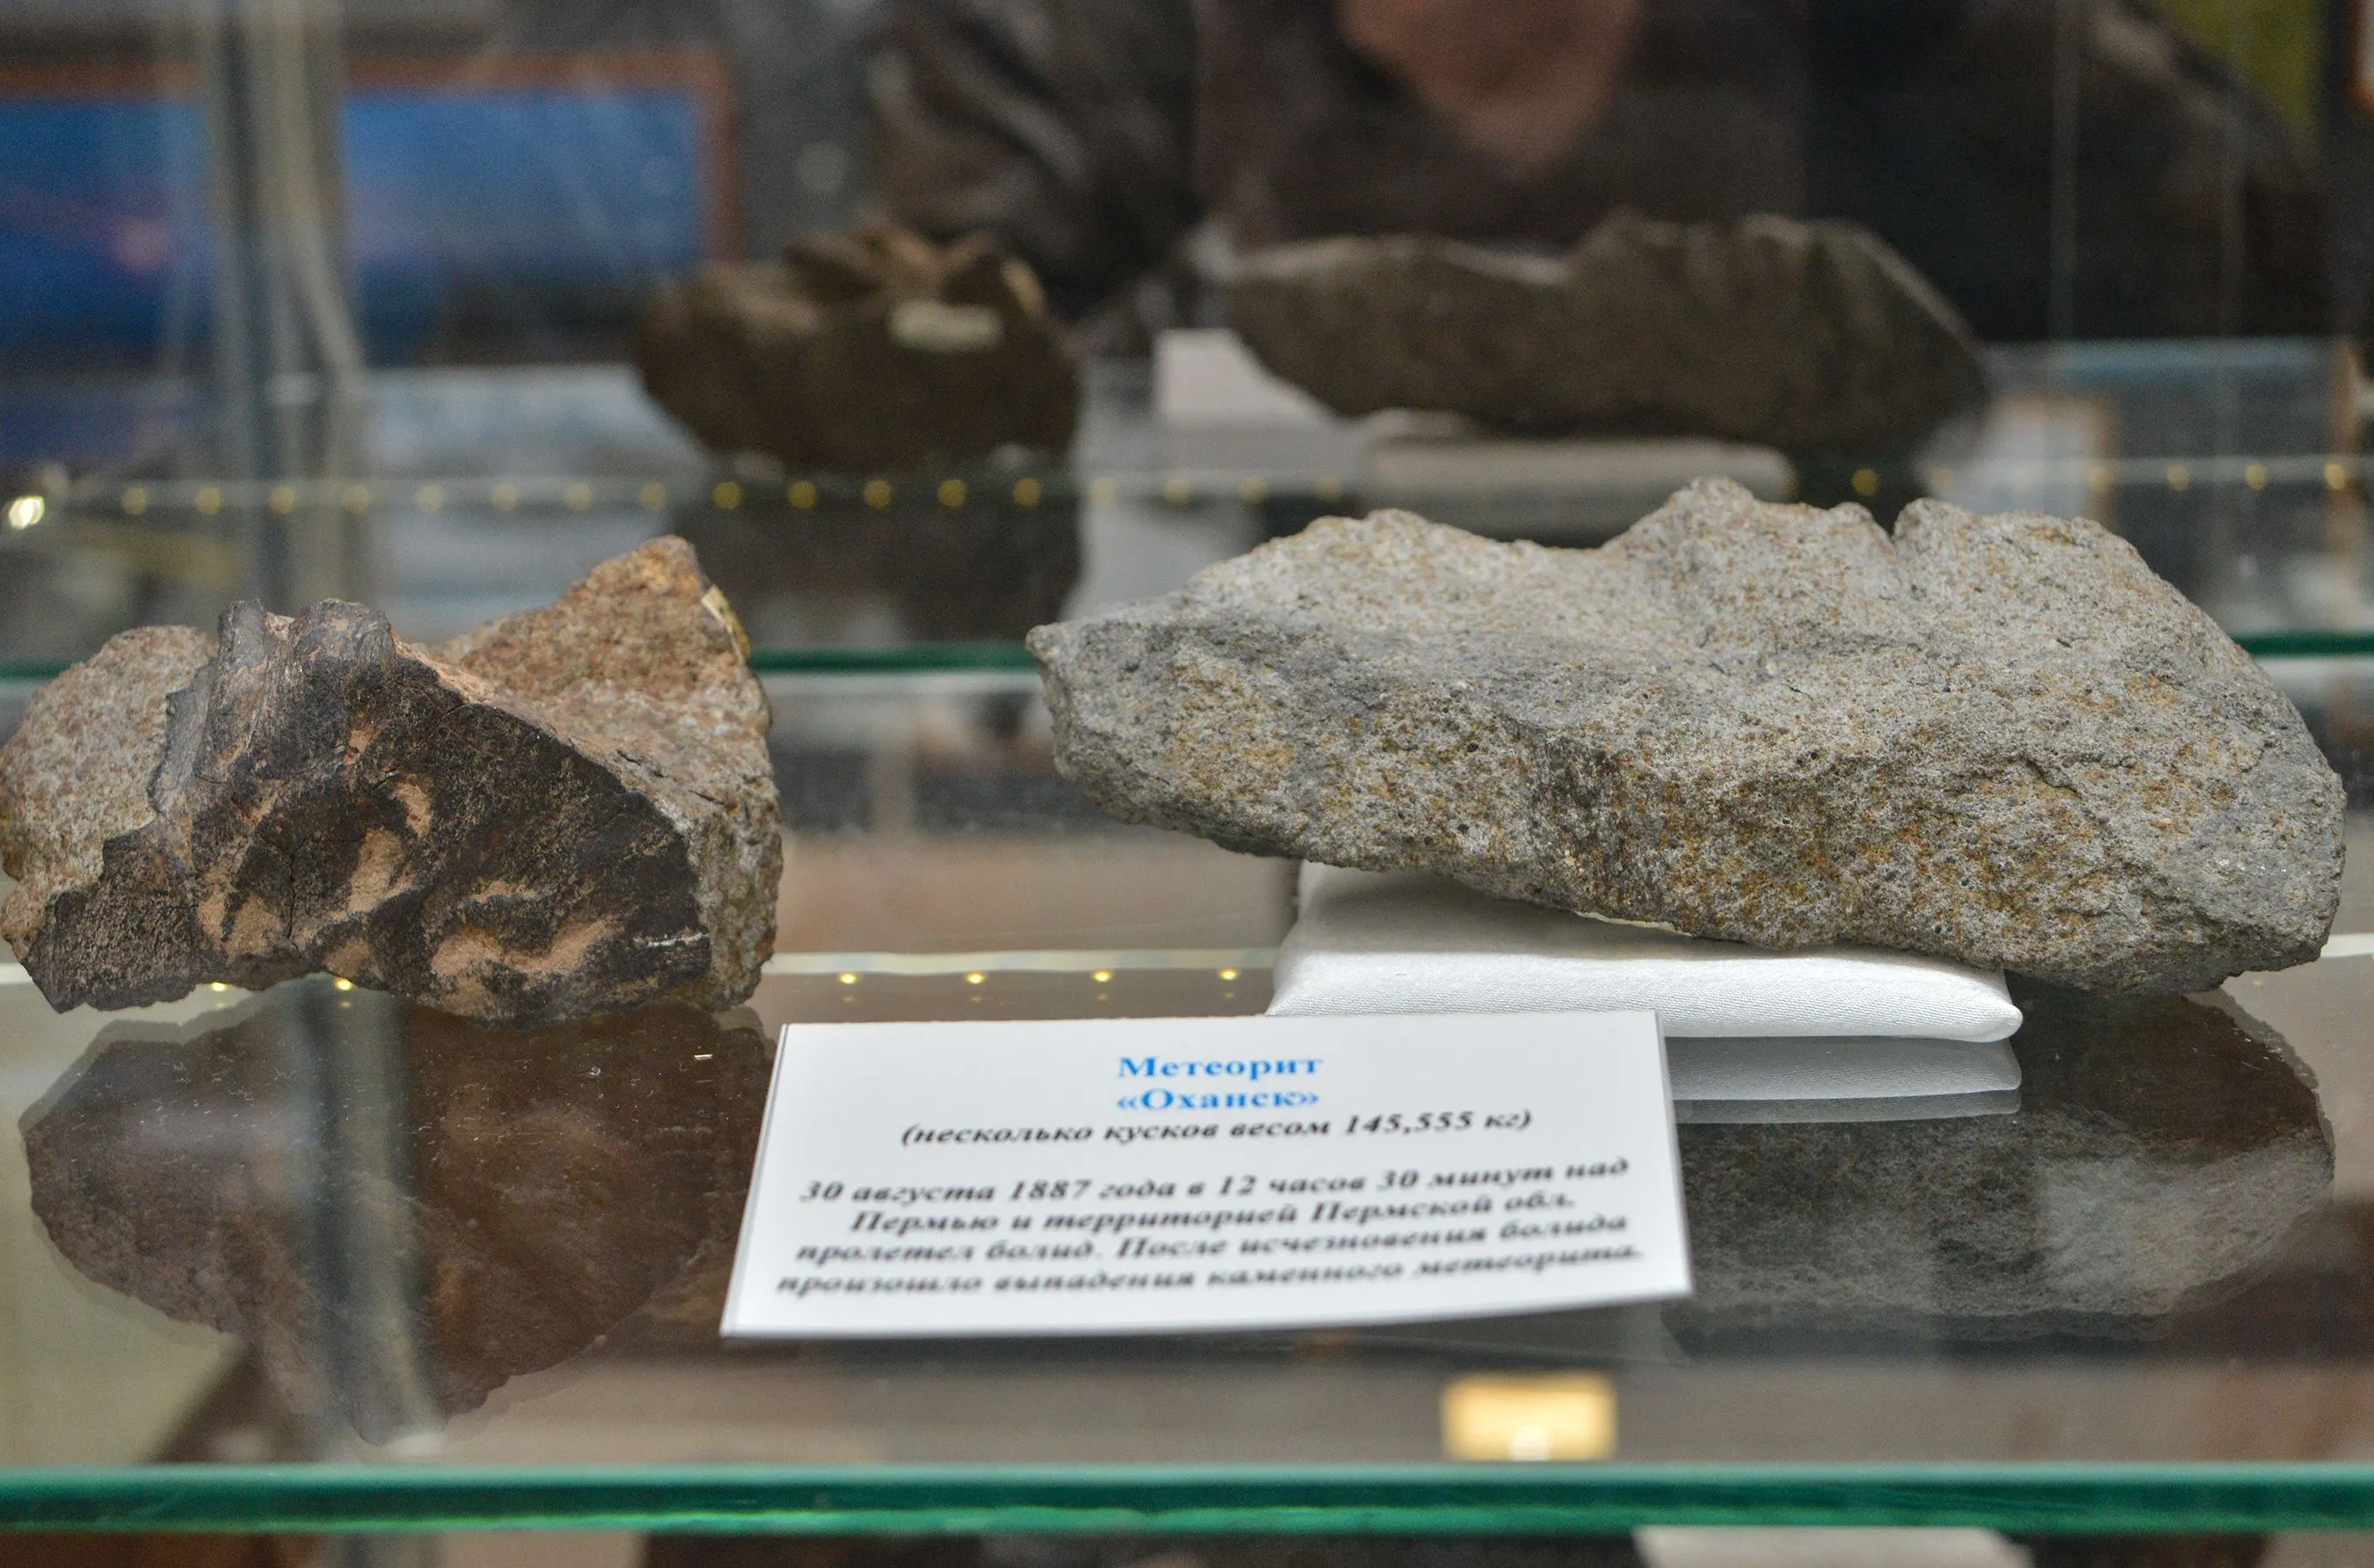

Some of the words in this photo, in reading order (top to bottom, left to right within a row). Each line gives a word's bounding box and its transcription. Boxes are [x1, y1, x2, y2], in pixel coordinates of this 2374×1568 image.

[1118, 1055, 1321, 1082] Метеорит
[1117, 1088, 1320, 1110] «Оханск»
[901, 1122, 1094, 1148] (несколько
[1103, 1123, 1220, 1146] кусков
[1229, 1120, 1332, 1138] весом
[1344, 1109, 1474, 1136] 145,555
[1483, 1109, 1533, 1130] кг)
[800, 1179, 844, 1202] 30
[850, 1184, 997, 1207] августа
[1009, 1178, 1092, 1202] 1887
[1098, 1178, 1177, 1200] года
[1187, 1182, 1206, 1198] в
[1218, 1175, 1257, 1197] 12
[1269, 1176, 1367, 1195] часов
[1377, 1169, 1420, 1190] 30
[1428, 1165, 1554, 1188] минут
[1565, 1157, 1630, 1179] над
[849, 1210, 999, 1237] Пермью
[1010, 1214, 1034, 1231] и
[1043, 1205, 1298, 1235] территорией
[1310, 1194, 1493, 1226] Пермской
[1503, 1190, 1576, 1212] обл.
[794, 1243, 976, 1267] пролетел
[1115, 1236, 1228, 1260] После
[1238, 1227, 1487, 1255] исчезновения
[1498, 1215, 1629, 1240] болида
